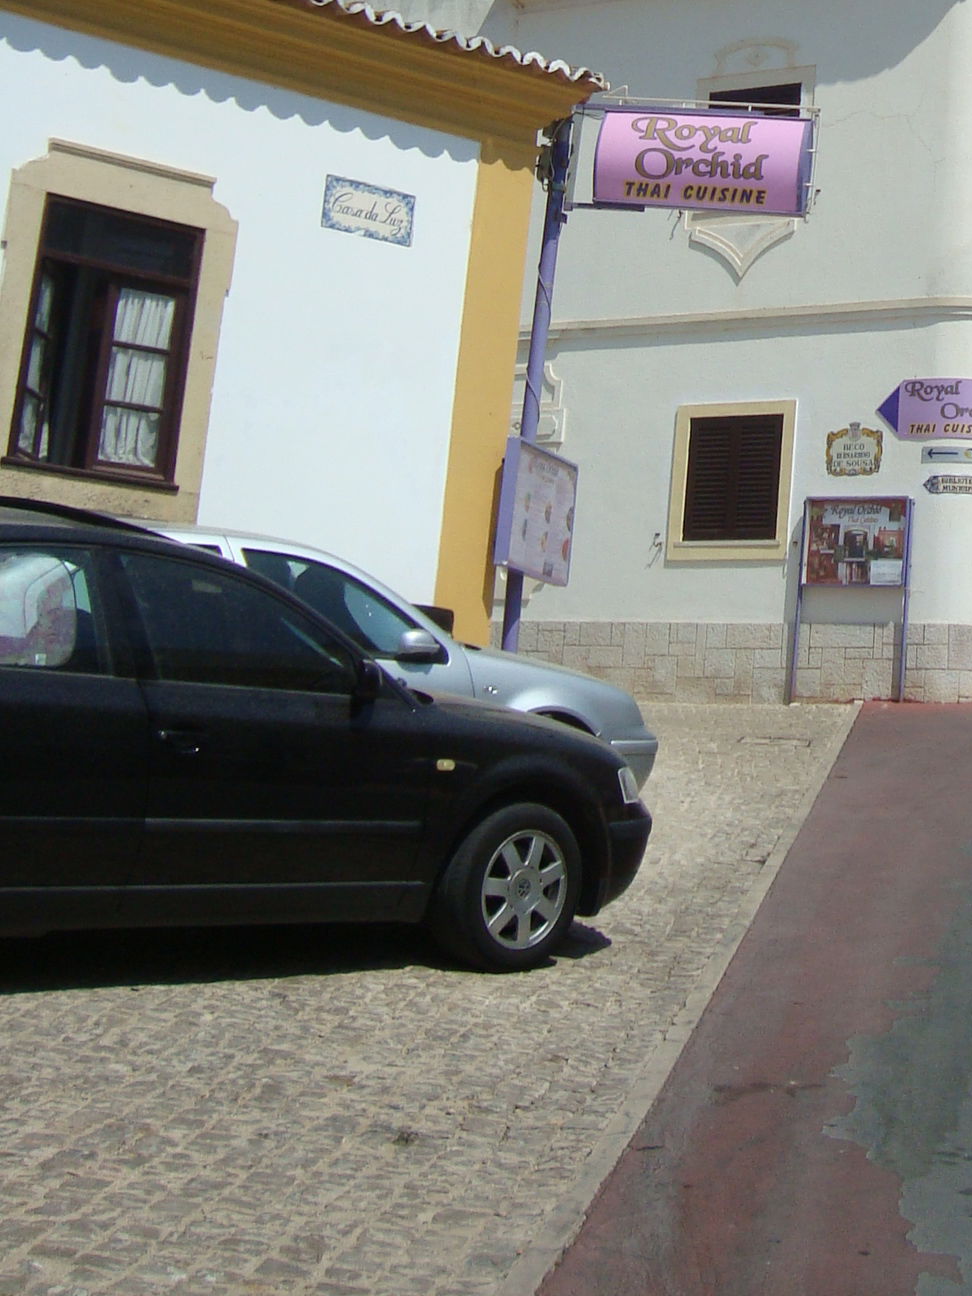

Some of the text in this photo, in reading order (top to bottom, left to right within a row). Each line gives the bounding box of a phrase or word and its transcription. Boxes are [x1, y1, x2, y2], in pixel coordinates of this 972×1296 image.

[631, 116, 757, 153] Royal
[634, 147, 770, 180] Orchid
[625, 181, 767, 205] THAI CUISINE
[332, 192, 404, 236] Casa da Luz
[904, 380, 962, 401] Royal
[909, 423, 937, 434] THAI
[846, 459, 873, 467] SOUSA
[831, 503, 855, 518] Royal
